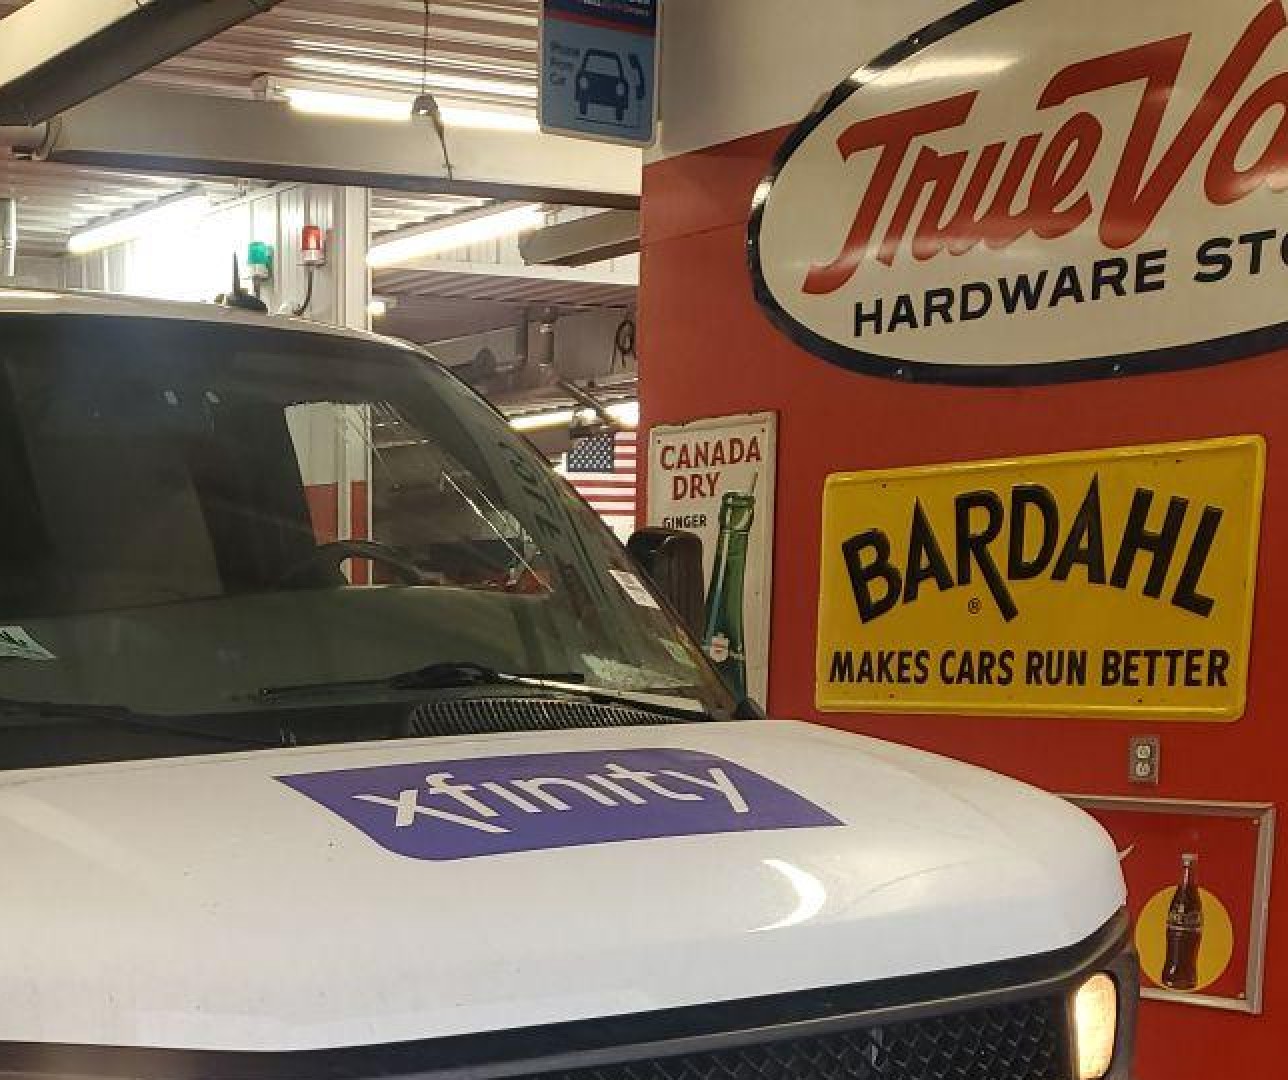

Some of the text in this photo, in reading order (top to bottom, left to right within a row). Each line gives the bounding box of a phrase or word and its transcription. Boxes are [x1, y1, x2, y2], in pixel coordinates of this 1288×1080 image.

[802, 90, 1104, 294] True
[853, 249, 1167, 337] HARDWARE
[660, 436, 762, 470] CANADA
[673, 472, 721, 501] DRY
[663, 513, 707, 529] GINGER
[841, 471, 1224, 624] BARDAHL
[829, 649, 1231, 688] MAKES CARS RUN BETTER
[352, 763, 750, 833] xfinity
